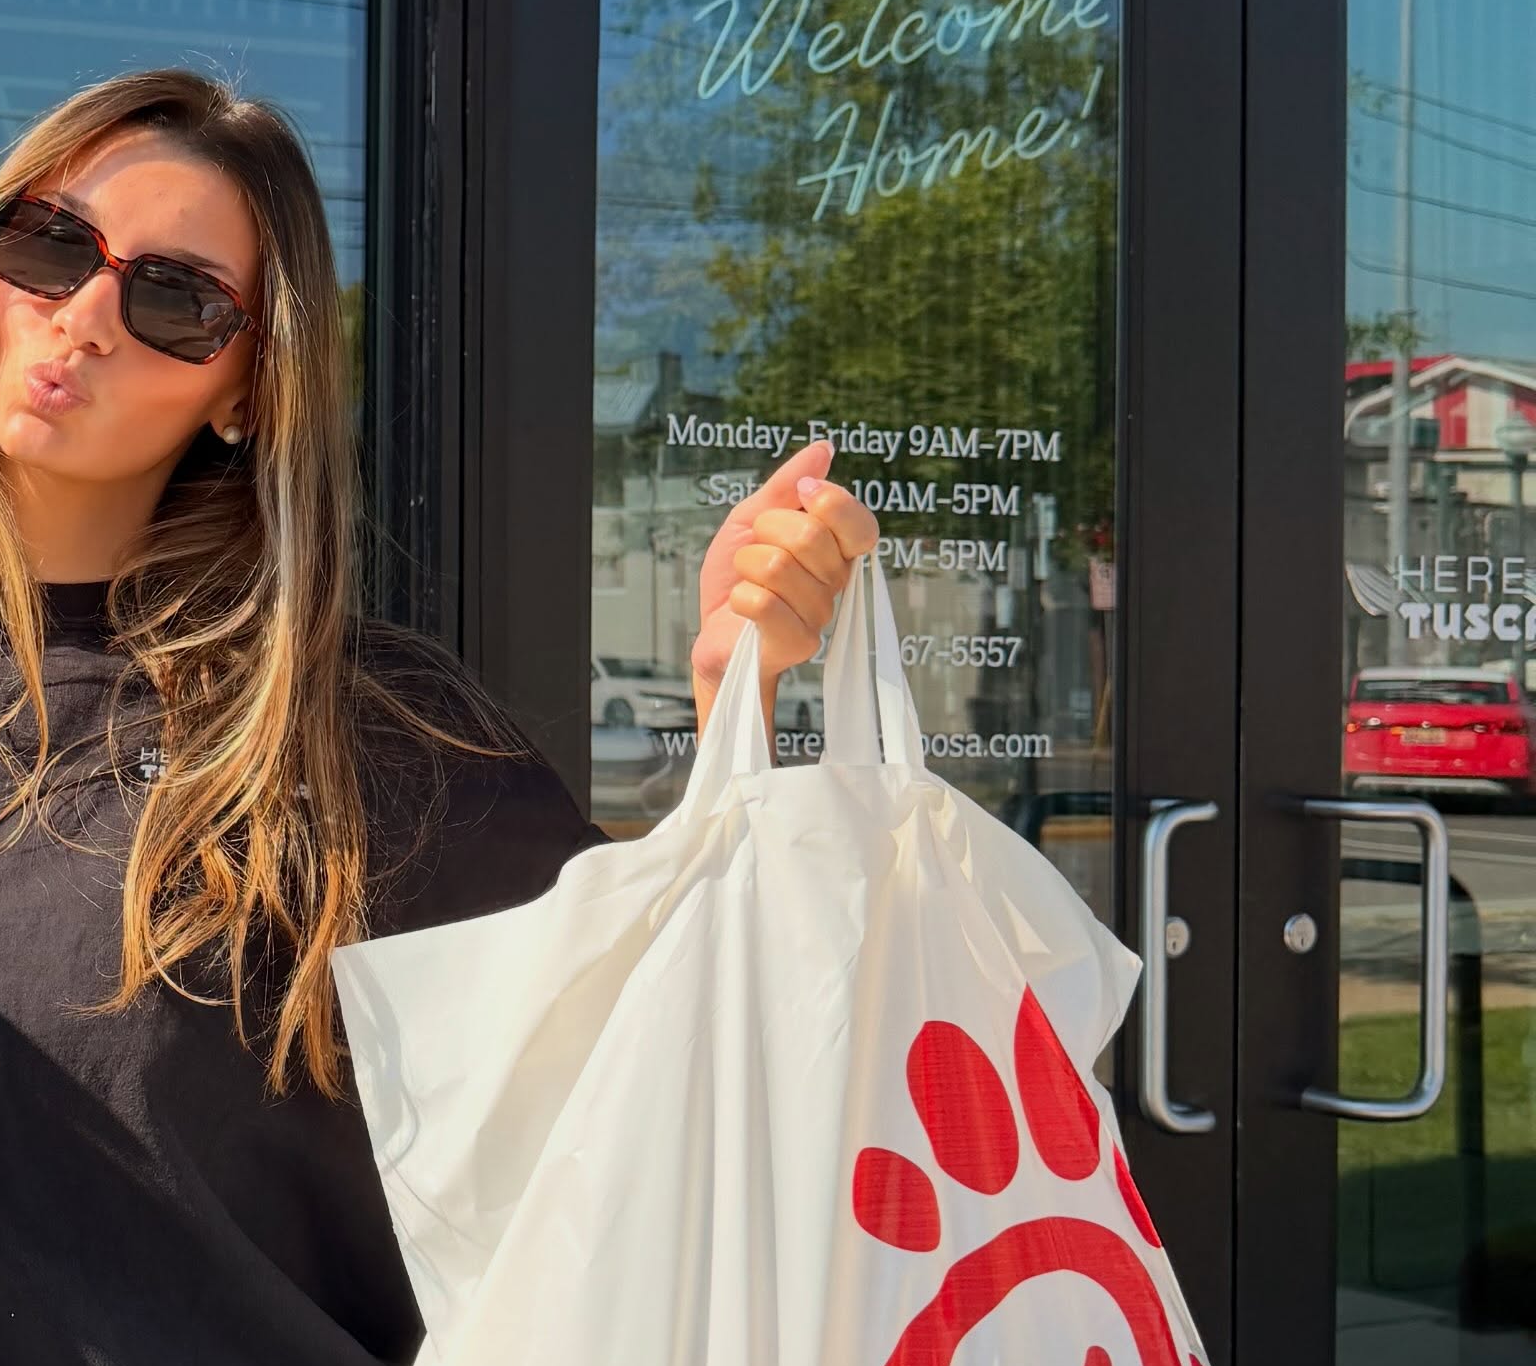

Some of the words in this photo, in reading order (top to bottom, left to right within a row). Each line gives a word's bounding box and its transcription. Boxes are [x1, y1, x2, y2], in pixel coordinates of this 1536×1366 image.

[797, 66, 1104, 223] Home!
[908, 424, 1063, 462] 9AM-7PM
[1397, 554, 1526, 595] HERE
